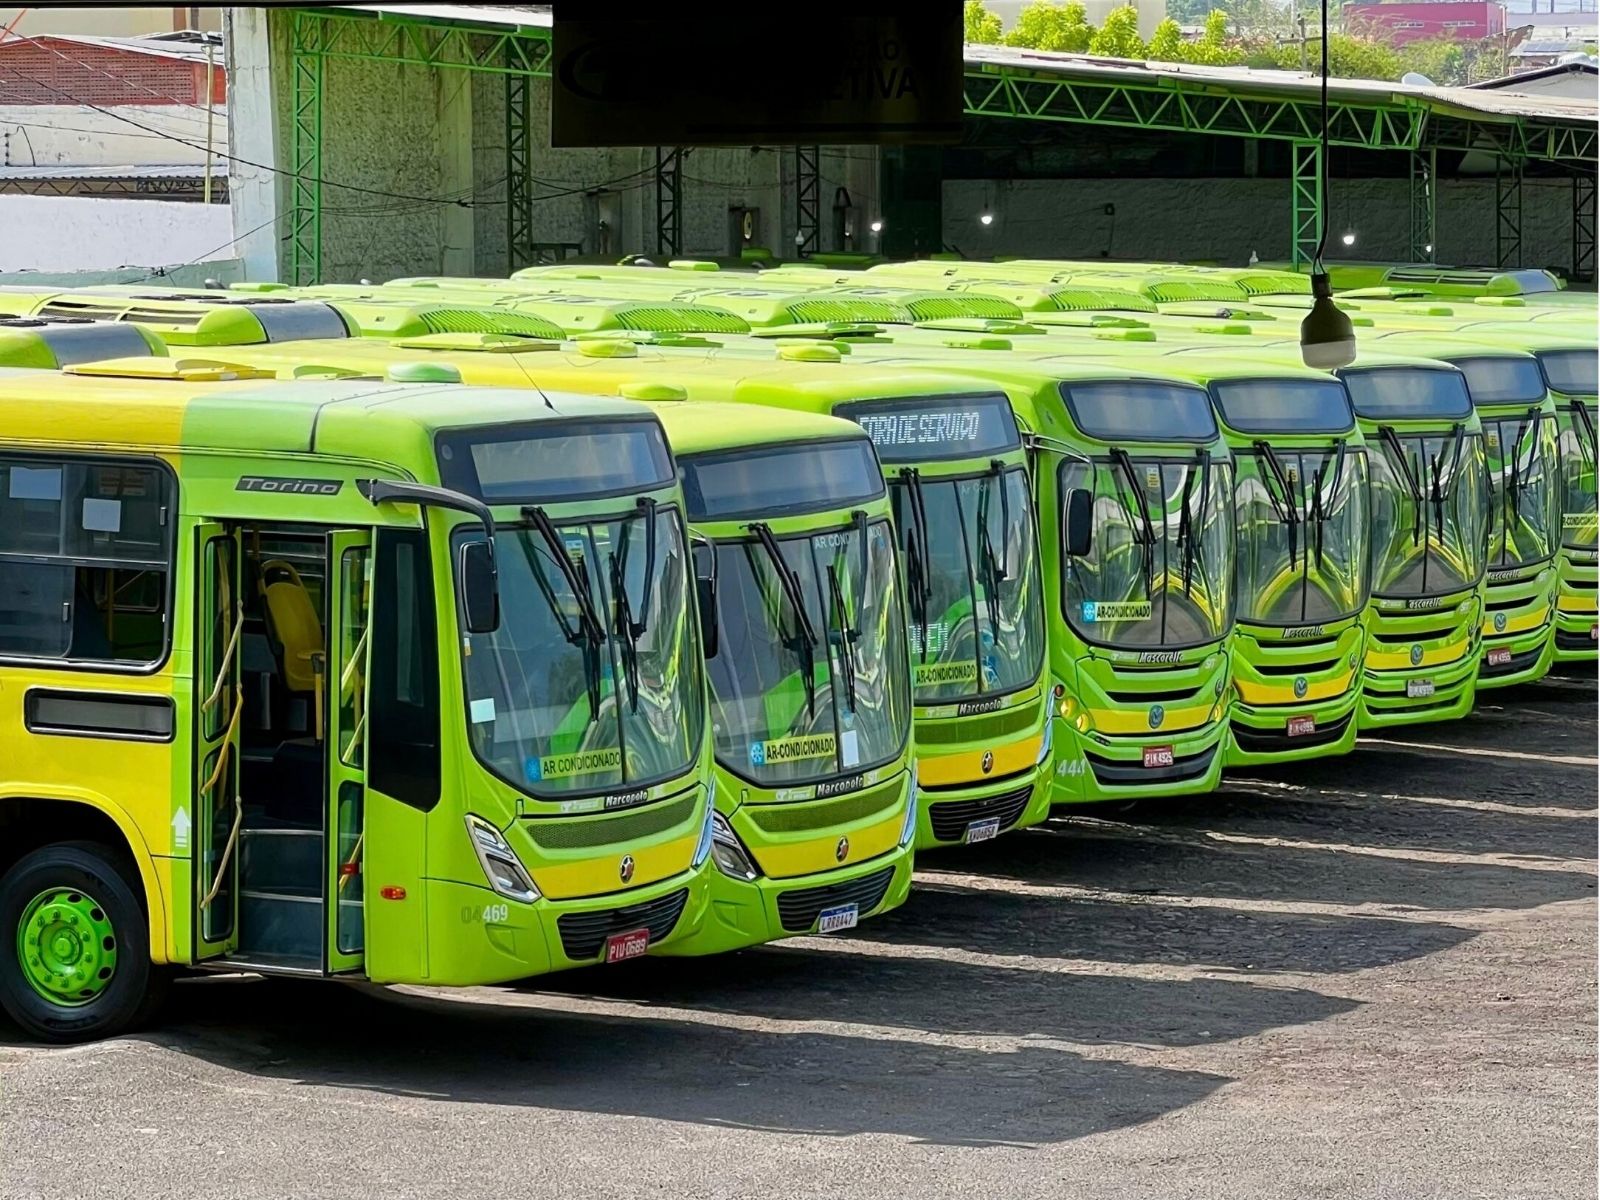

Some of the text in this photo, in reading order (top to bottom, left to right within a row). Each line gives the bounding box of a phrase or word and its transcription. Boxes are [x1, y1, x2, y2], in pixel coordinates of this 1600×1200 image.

[898, 415, 918, 443] DE
[241, 477, 338, 493] Torino
[815, 537, 828, 550] AR
[1096, 602, 1151, 618] AR-CONDICIONADO
[916, 664, 976, 684] AR-CONDICIONADO
[959, 699, 1001, 715] Marcopolo
[766, 737, 835, 760] AR-CONDICIONADO
[543, 752, 621, 775] AR CONDICIONADO
[817, 776, 864, 796] Marcopolo
[605, 789, 648, 808] Marcopolo
